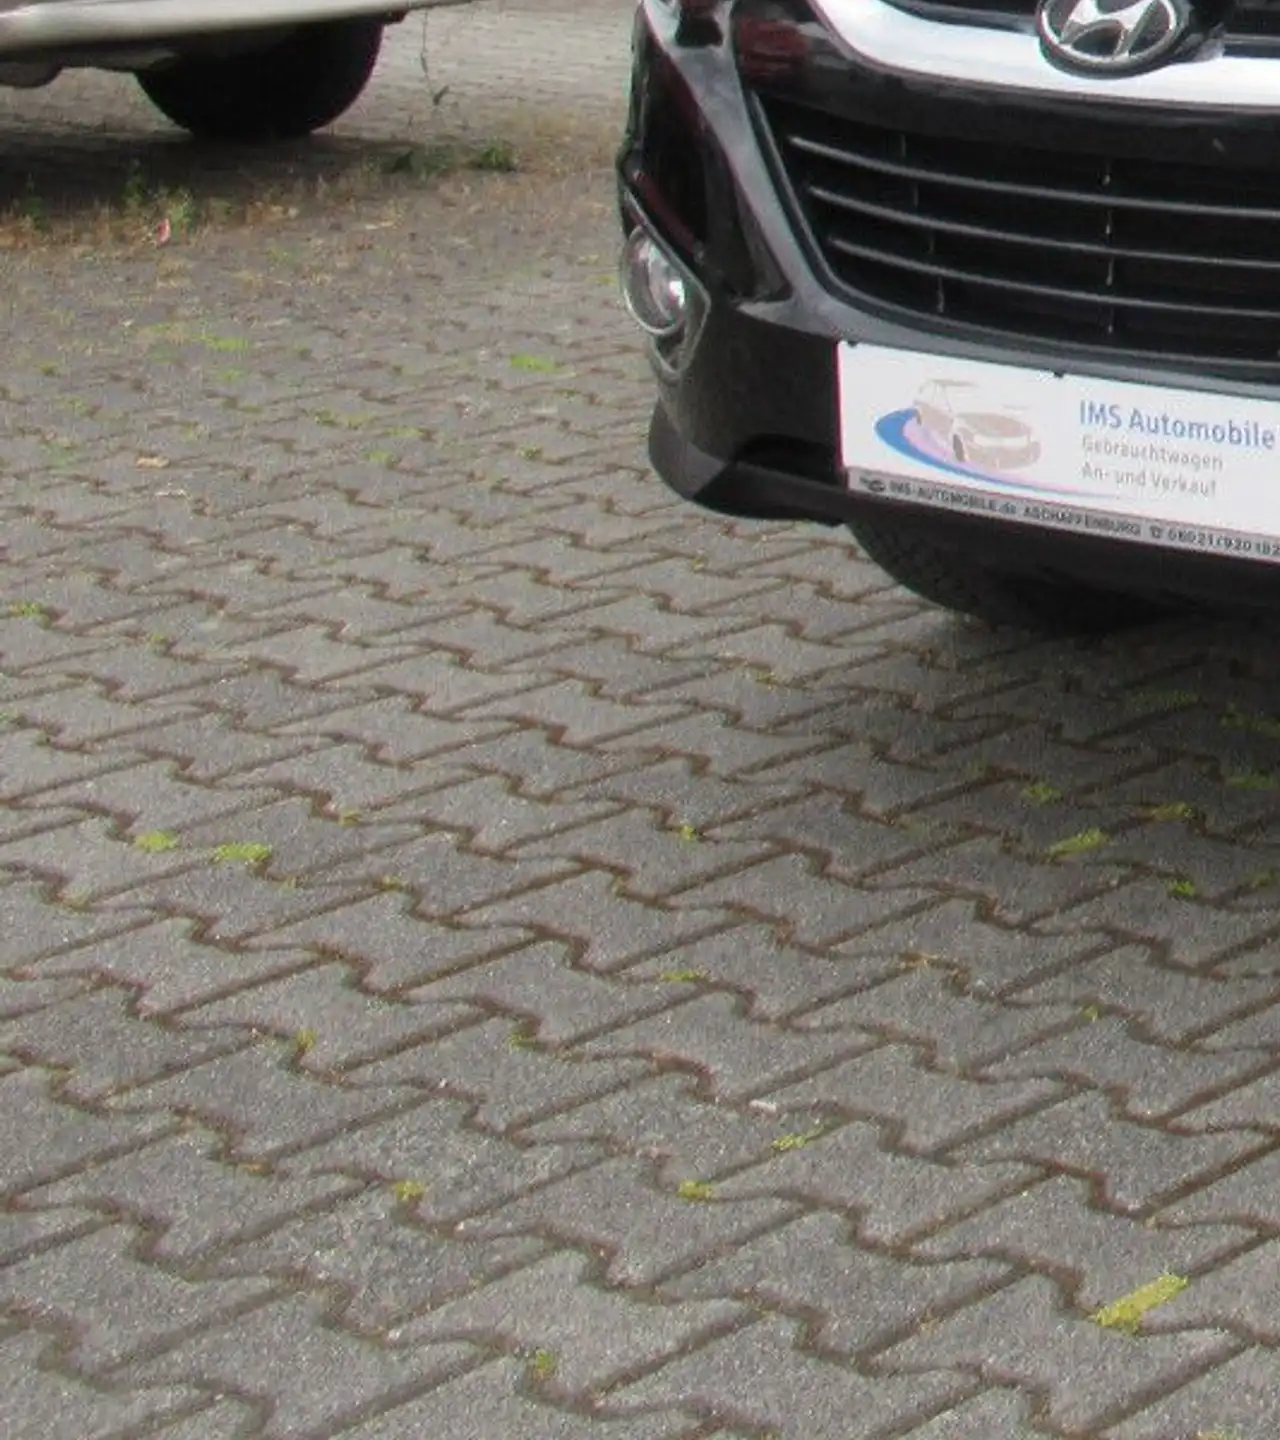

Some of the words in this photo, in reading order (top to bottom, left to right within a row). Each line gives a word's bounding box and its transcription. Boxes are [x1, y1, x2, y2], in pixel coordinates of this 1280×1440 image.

[1079, 399, 1122, 430] IMS
[1129, 407, 1276, 450] Automobile
[1082, 434, 1223, 472] Gebrauchtwagen
[1082, 460, 1109, 479] An-
[1115, 468, 1146, 487] und
[1151, 473, 1217, 495] Verkauf
